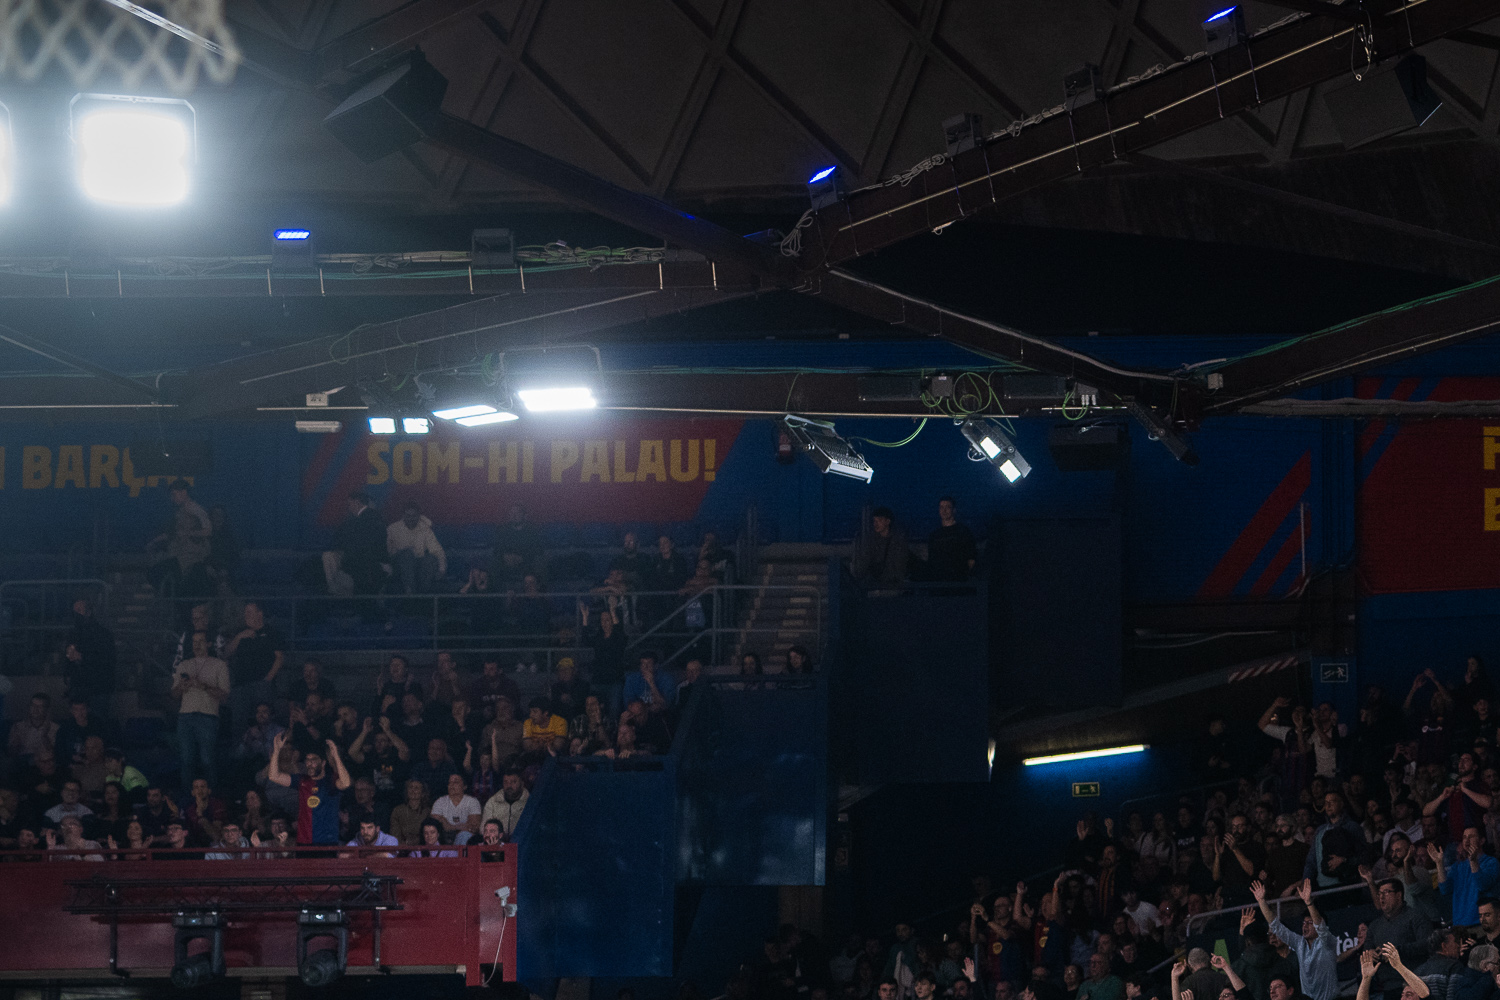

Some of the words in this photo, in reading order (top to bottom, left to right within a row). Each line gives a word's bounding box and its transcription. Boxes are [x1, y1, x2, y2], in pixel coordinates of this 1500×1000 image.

[22, 444, 194, 498] BARÇ
[366, 440, 534, 485] SOM-HI
[552, 438, 717, 483] PALAU!
